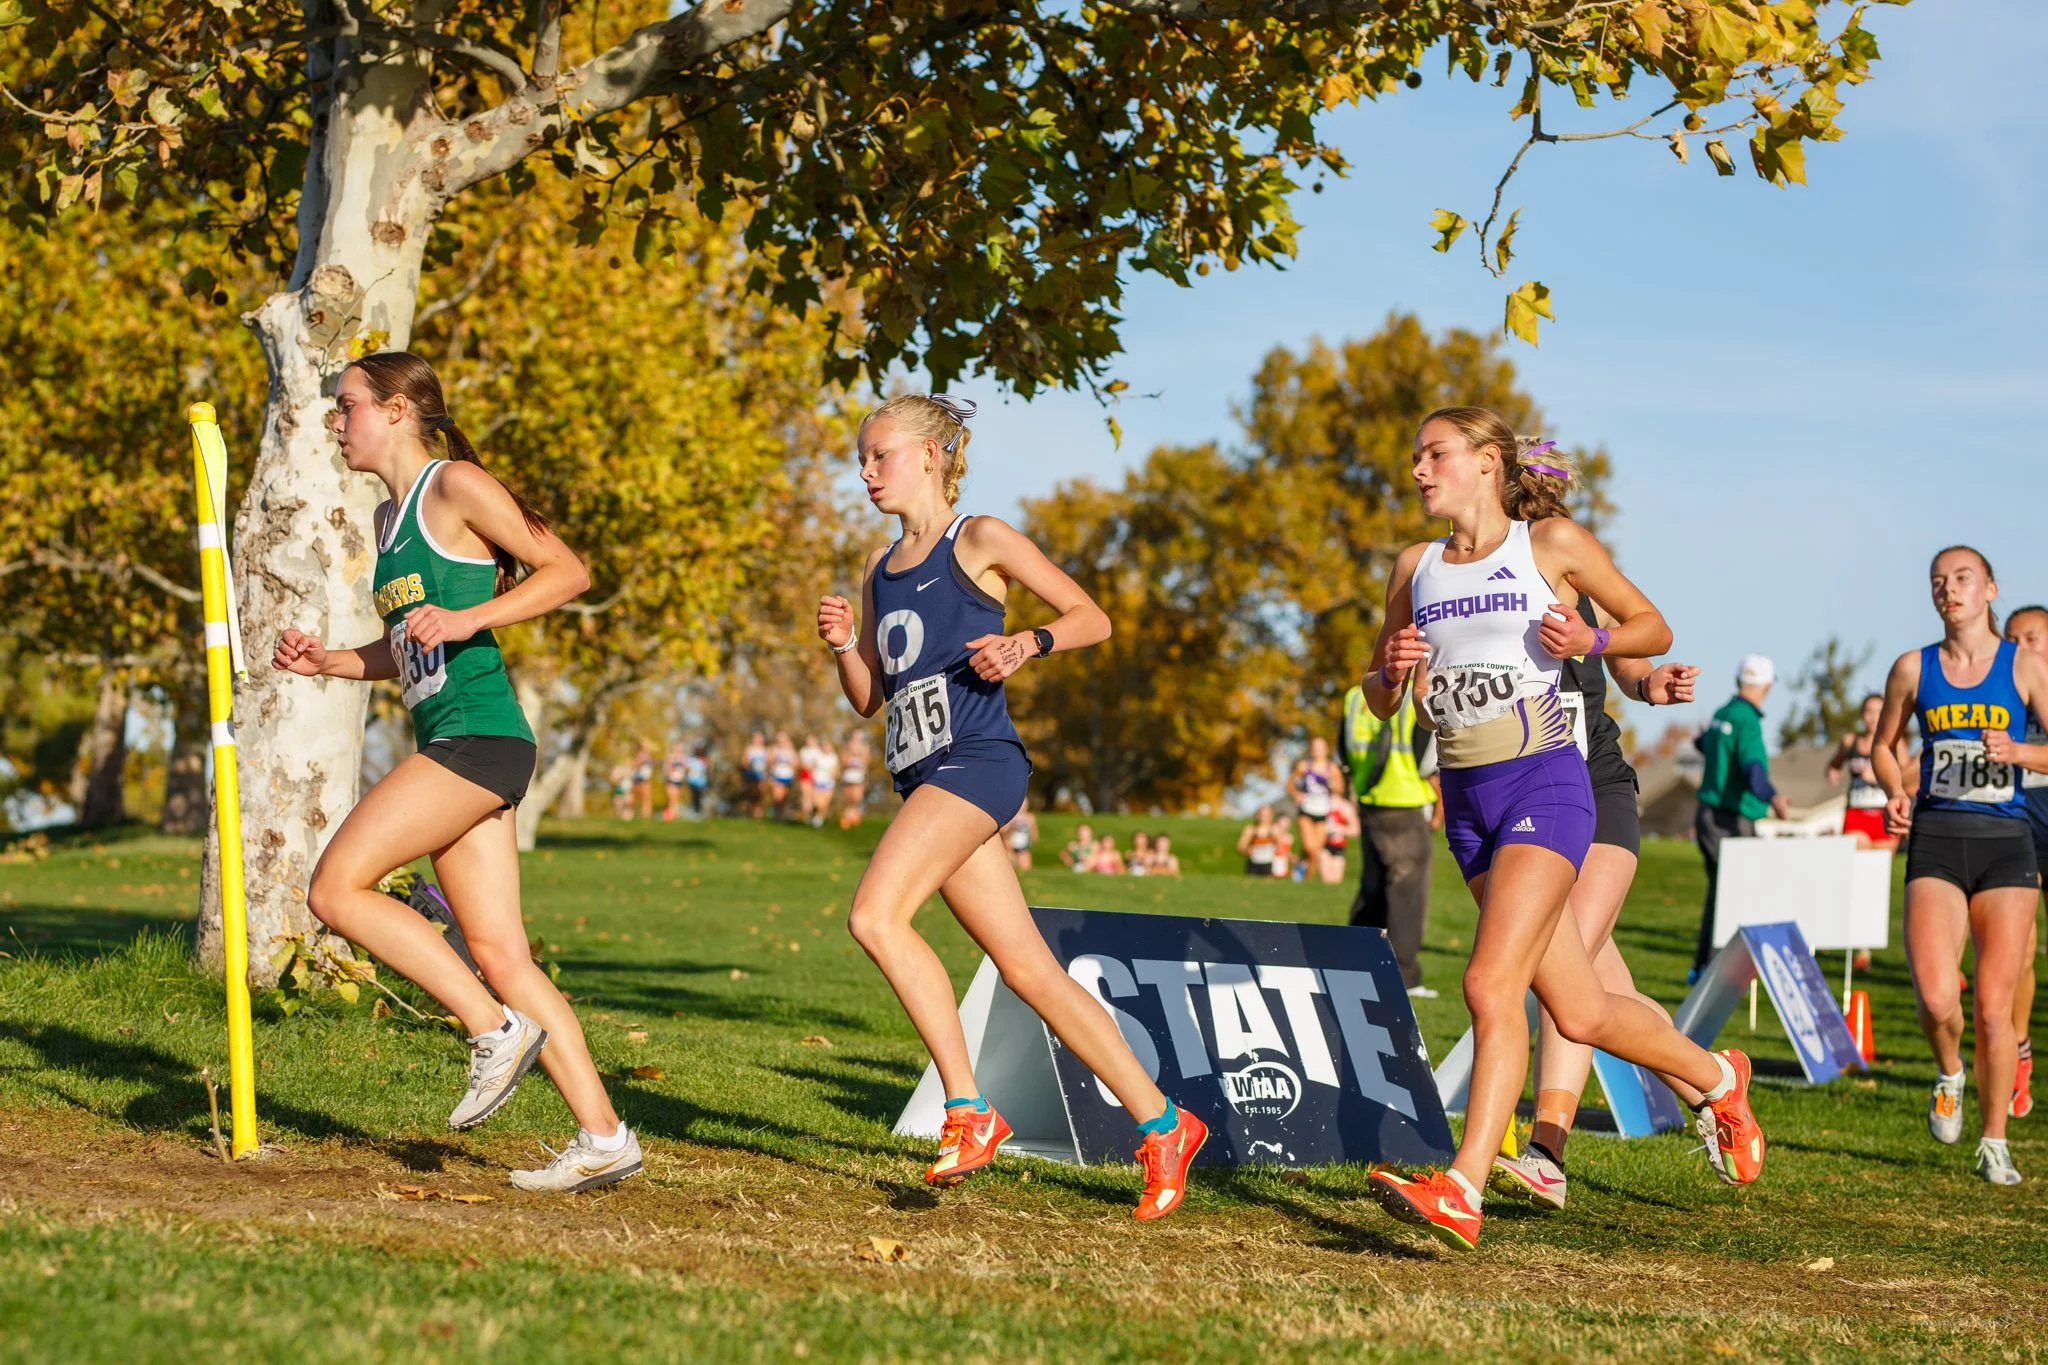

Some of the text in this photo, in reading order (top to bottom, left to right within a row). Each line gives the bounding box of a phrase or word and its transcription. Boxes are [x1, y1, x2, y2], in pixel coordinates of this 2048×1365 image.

[877, 609, 924, 675] O
[909, 678, 937, 693] COUNTRY
[1429, 672, 1515, 716] 2150
[887, 686, 946, 763] 2215
[1925, 704, 2010, 733] MEAD
[1935, 750, 2009, 790] 2183
[1067, 953, 1419, 1122] STATE
[1230, 1075, 1293, 1100] WIAA
